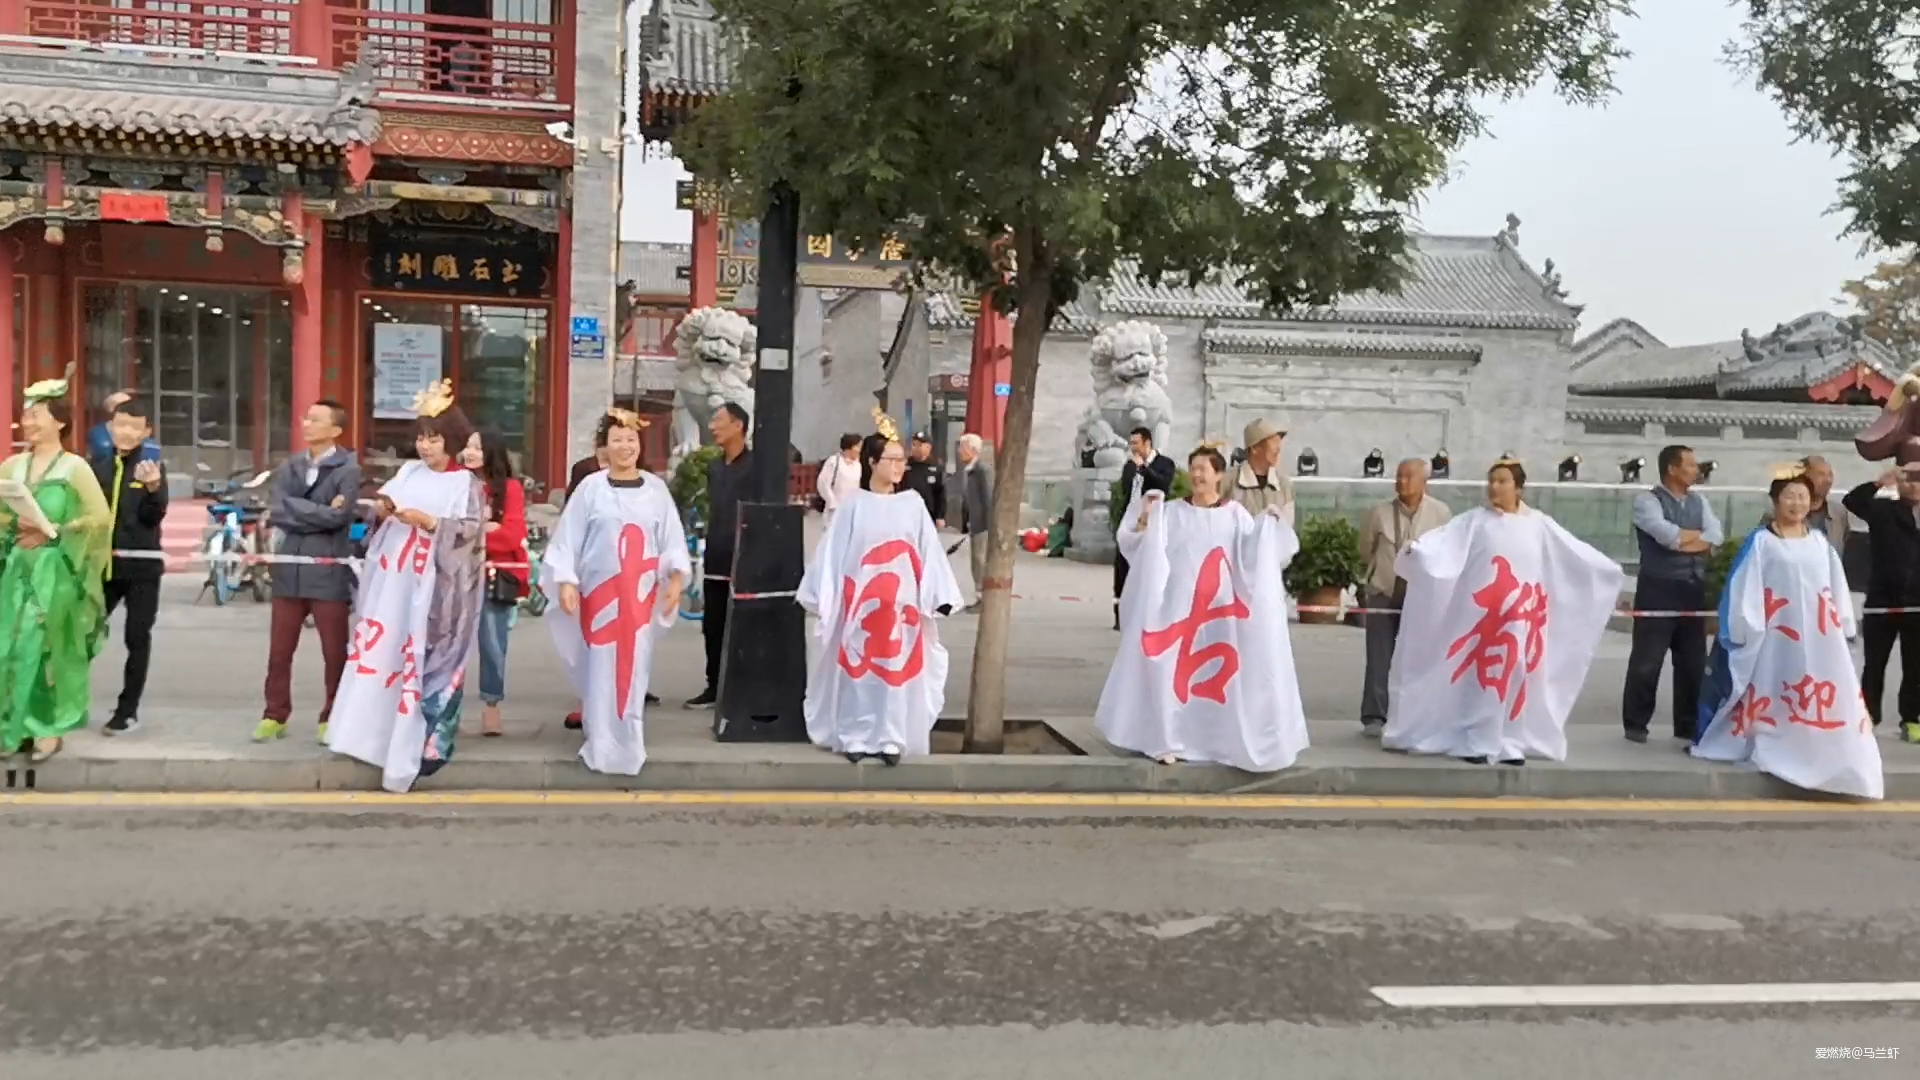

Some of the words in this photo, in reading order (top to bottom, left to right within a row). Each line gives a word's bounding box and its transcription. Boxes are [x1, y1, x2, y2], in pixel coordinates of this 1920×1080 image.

[580, 523, 660, 720] 中
[837, 539, 924, 687] 国
[1141, 546, 1250, 704] 古
[1446, 555, 1549, 721] 都
